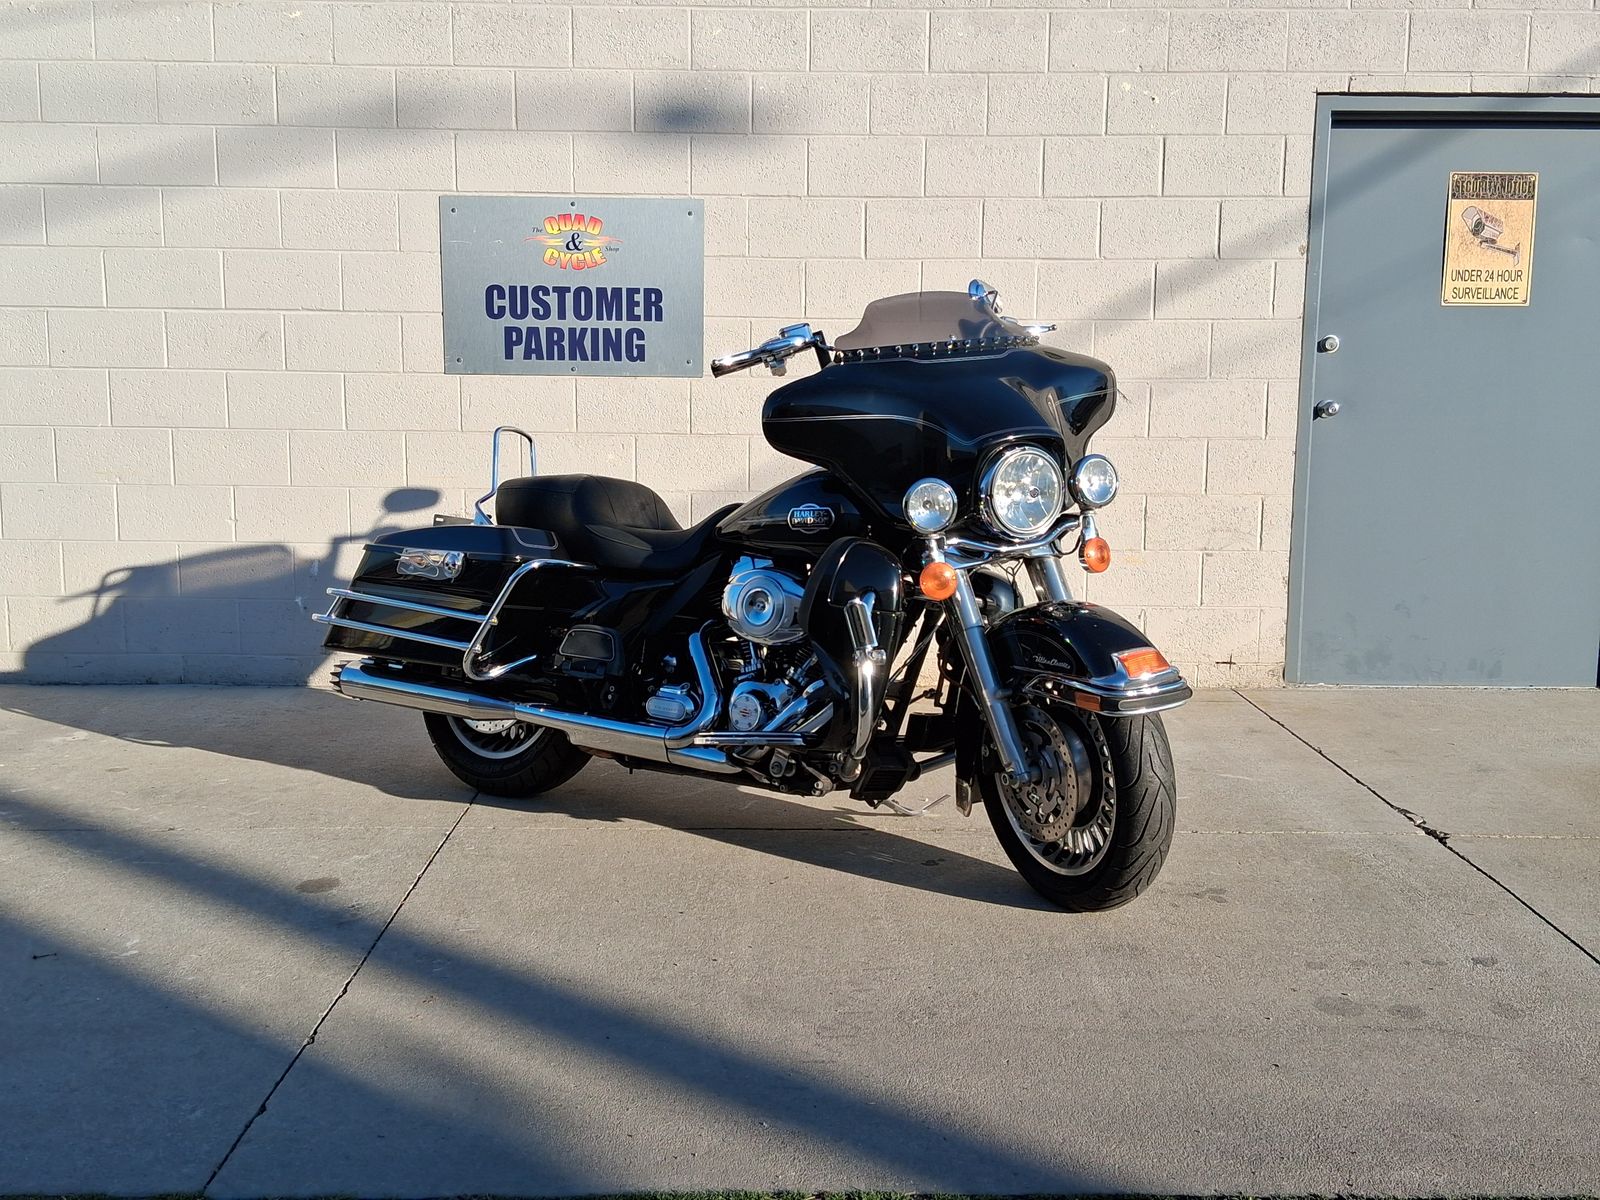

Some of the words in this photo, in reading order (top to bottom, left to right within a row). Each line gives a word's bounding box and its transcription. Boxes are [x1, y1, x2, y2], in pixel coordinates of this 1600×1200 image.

[543, 213, 603, 235] QUAD
[565, 232, 583, 251] &
[543, 247, 608, 271] CYCLE
[1451, 269, 1482, 282] UNDER
[1484, 269, 1495, 282] 24
[1497, 269, 1523, 282] HOUR
[485, 283, 664, 322] CUSTOMER
[1451, 287, 1519, 300] SURVEILLANCE
[504, 326, 646, 363] PARKING
